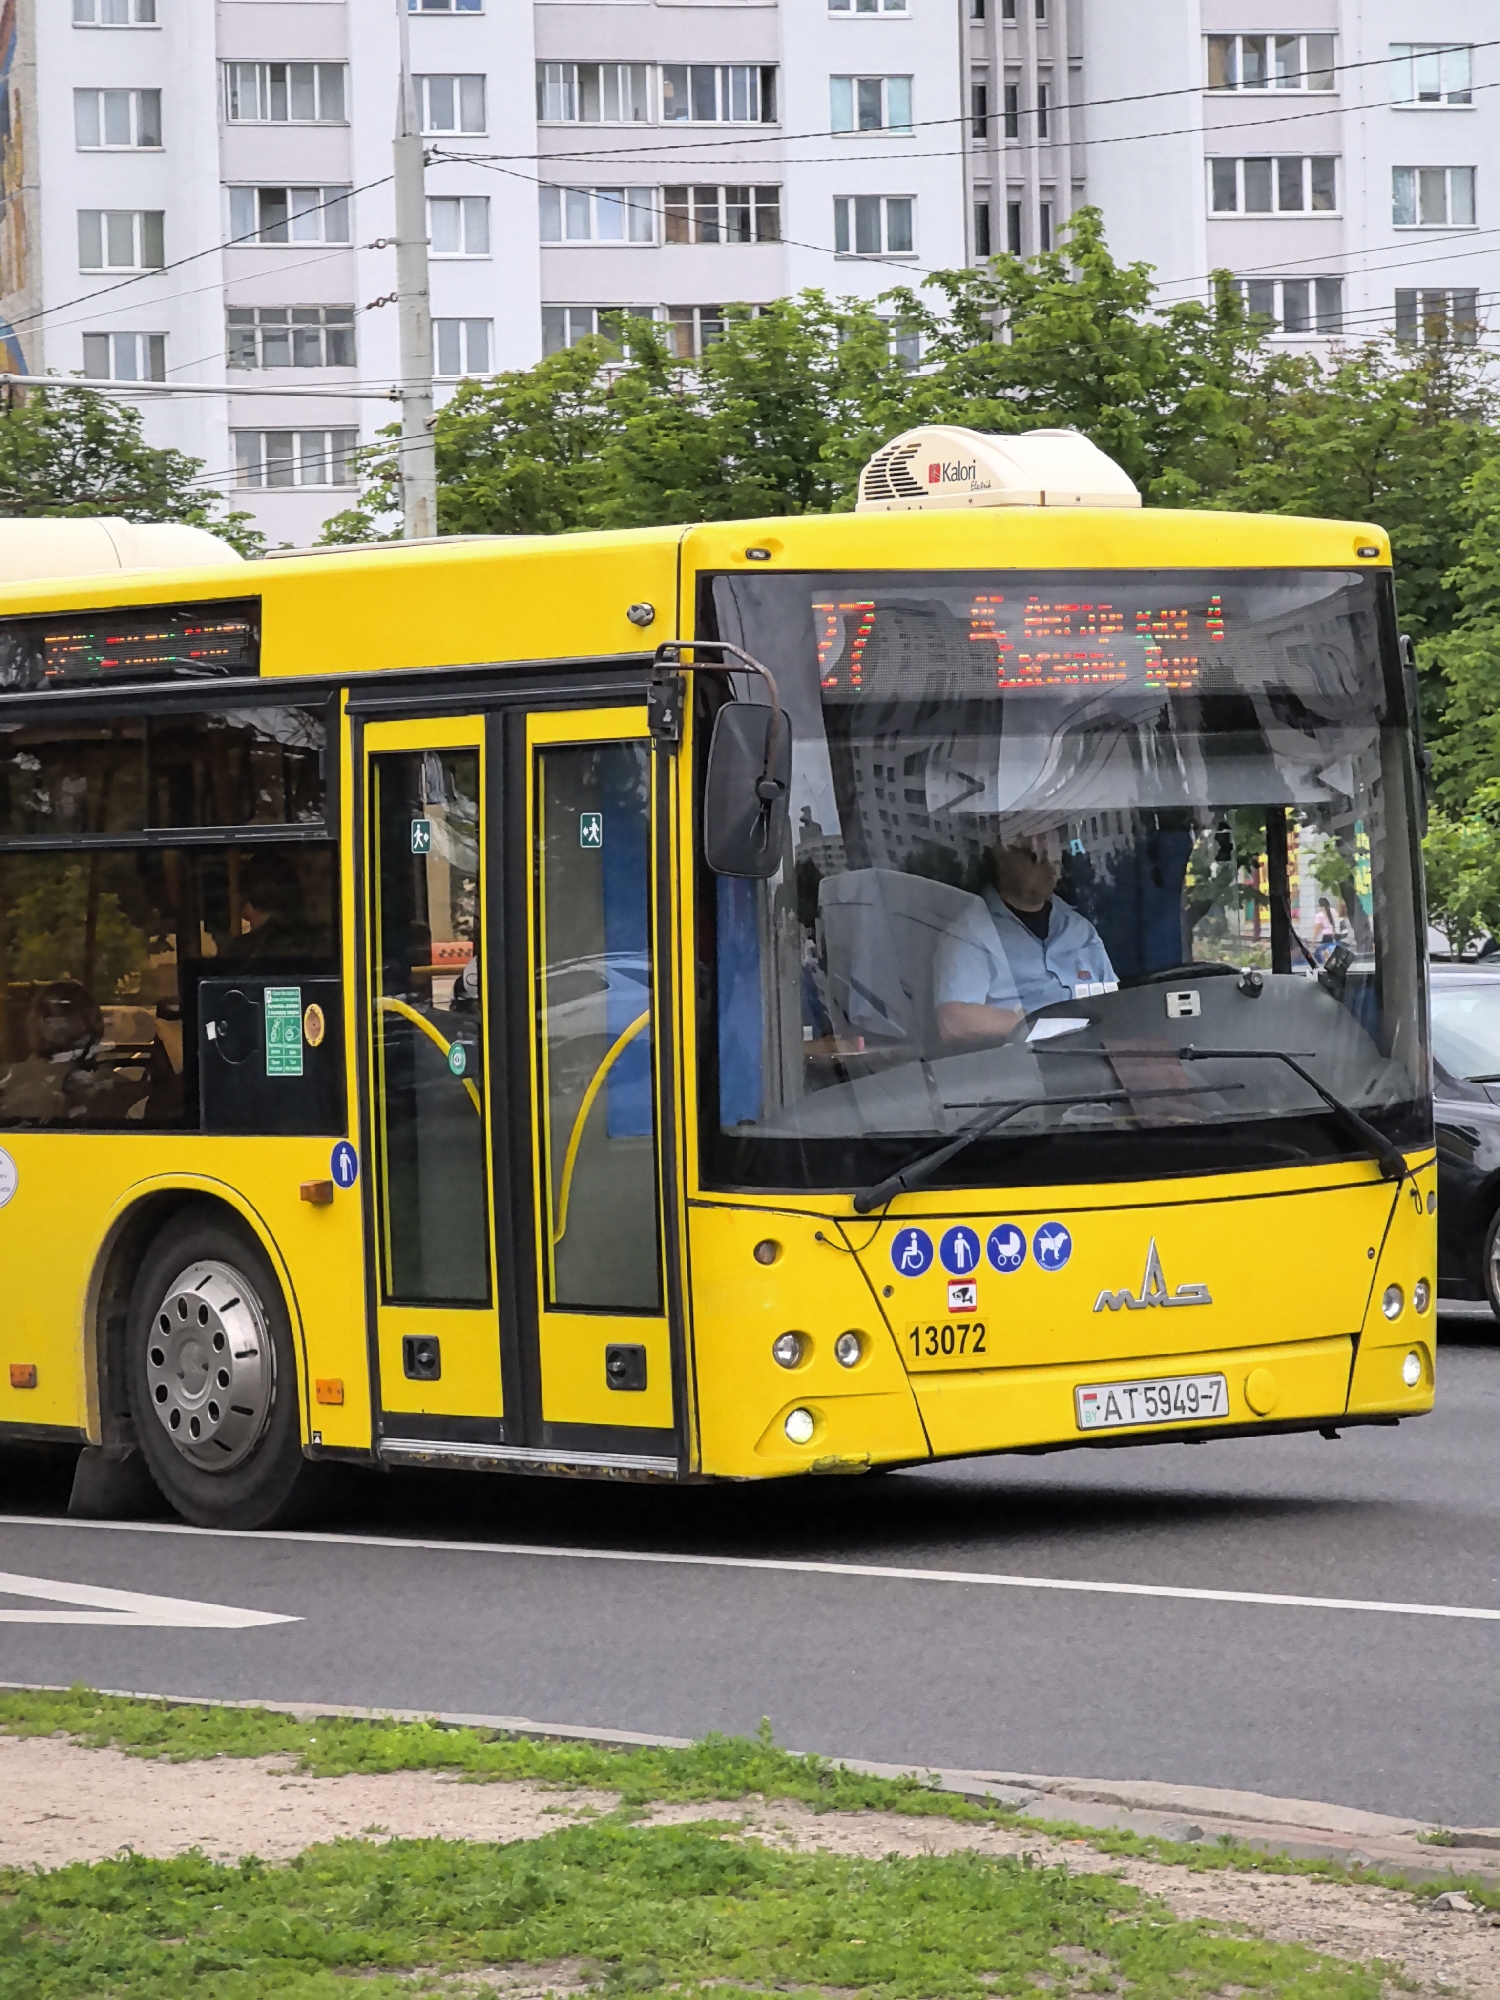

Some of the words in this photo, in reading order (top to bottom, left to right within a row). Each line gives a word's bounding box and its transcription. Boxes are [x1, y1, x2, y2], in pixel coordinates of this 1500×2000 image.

[943, 459, 976, 482] Kalori
[909, 1323, 986, 1357] 13072
[1085, 1410, 1098, 1423] BY
